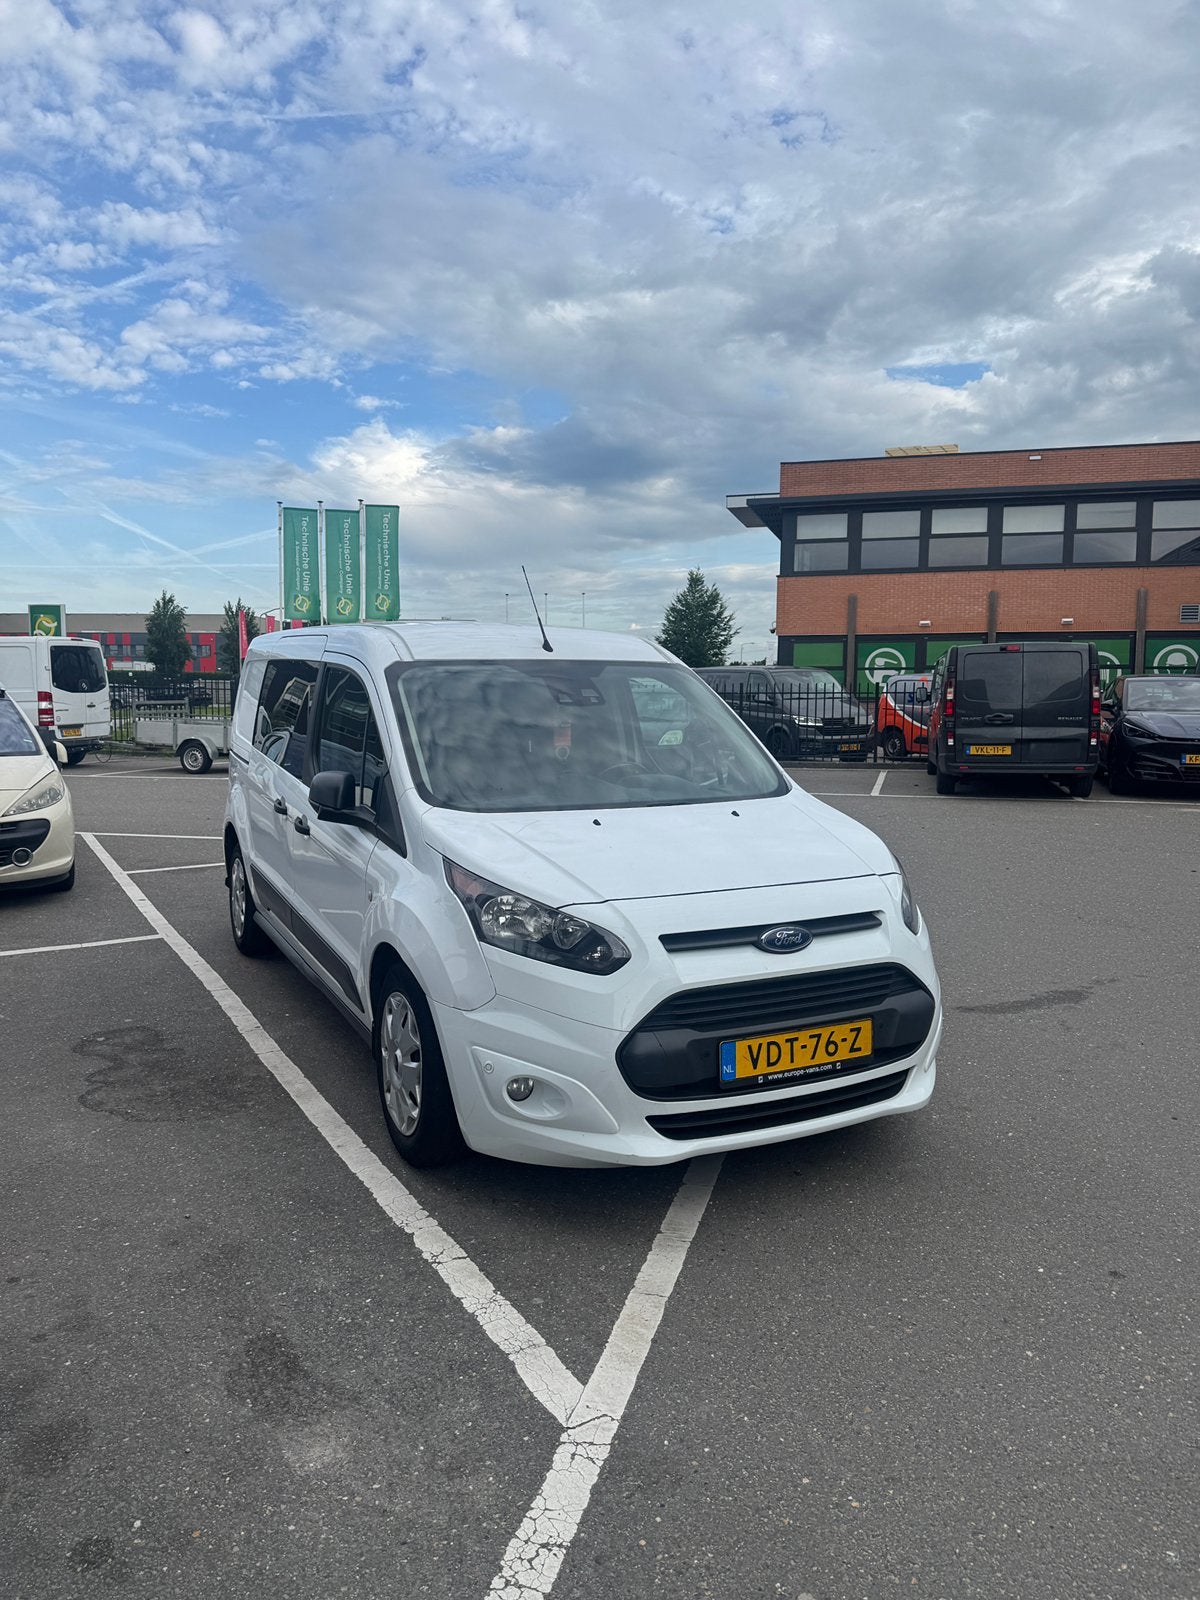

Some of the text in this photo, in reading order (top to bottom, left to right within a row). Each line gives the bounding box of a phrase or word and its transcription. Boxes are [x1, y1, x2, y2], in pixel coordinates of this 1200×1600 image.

[302, 516, 311, 592] Technische Unie
[343, 517, 353, 594] Technische Unie
[383, 512, 391, 590] Technische Unie
[974, 746, 1007, 754] VKL-11-F
[775, 930, 802, 945] Ford
[747, 1026, 862, 1070] VDT-76-Z
[723, 1065, 734, 1074] NL
[767, 1064, 832, 1081] www.europe-vans.com
